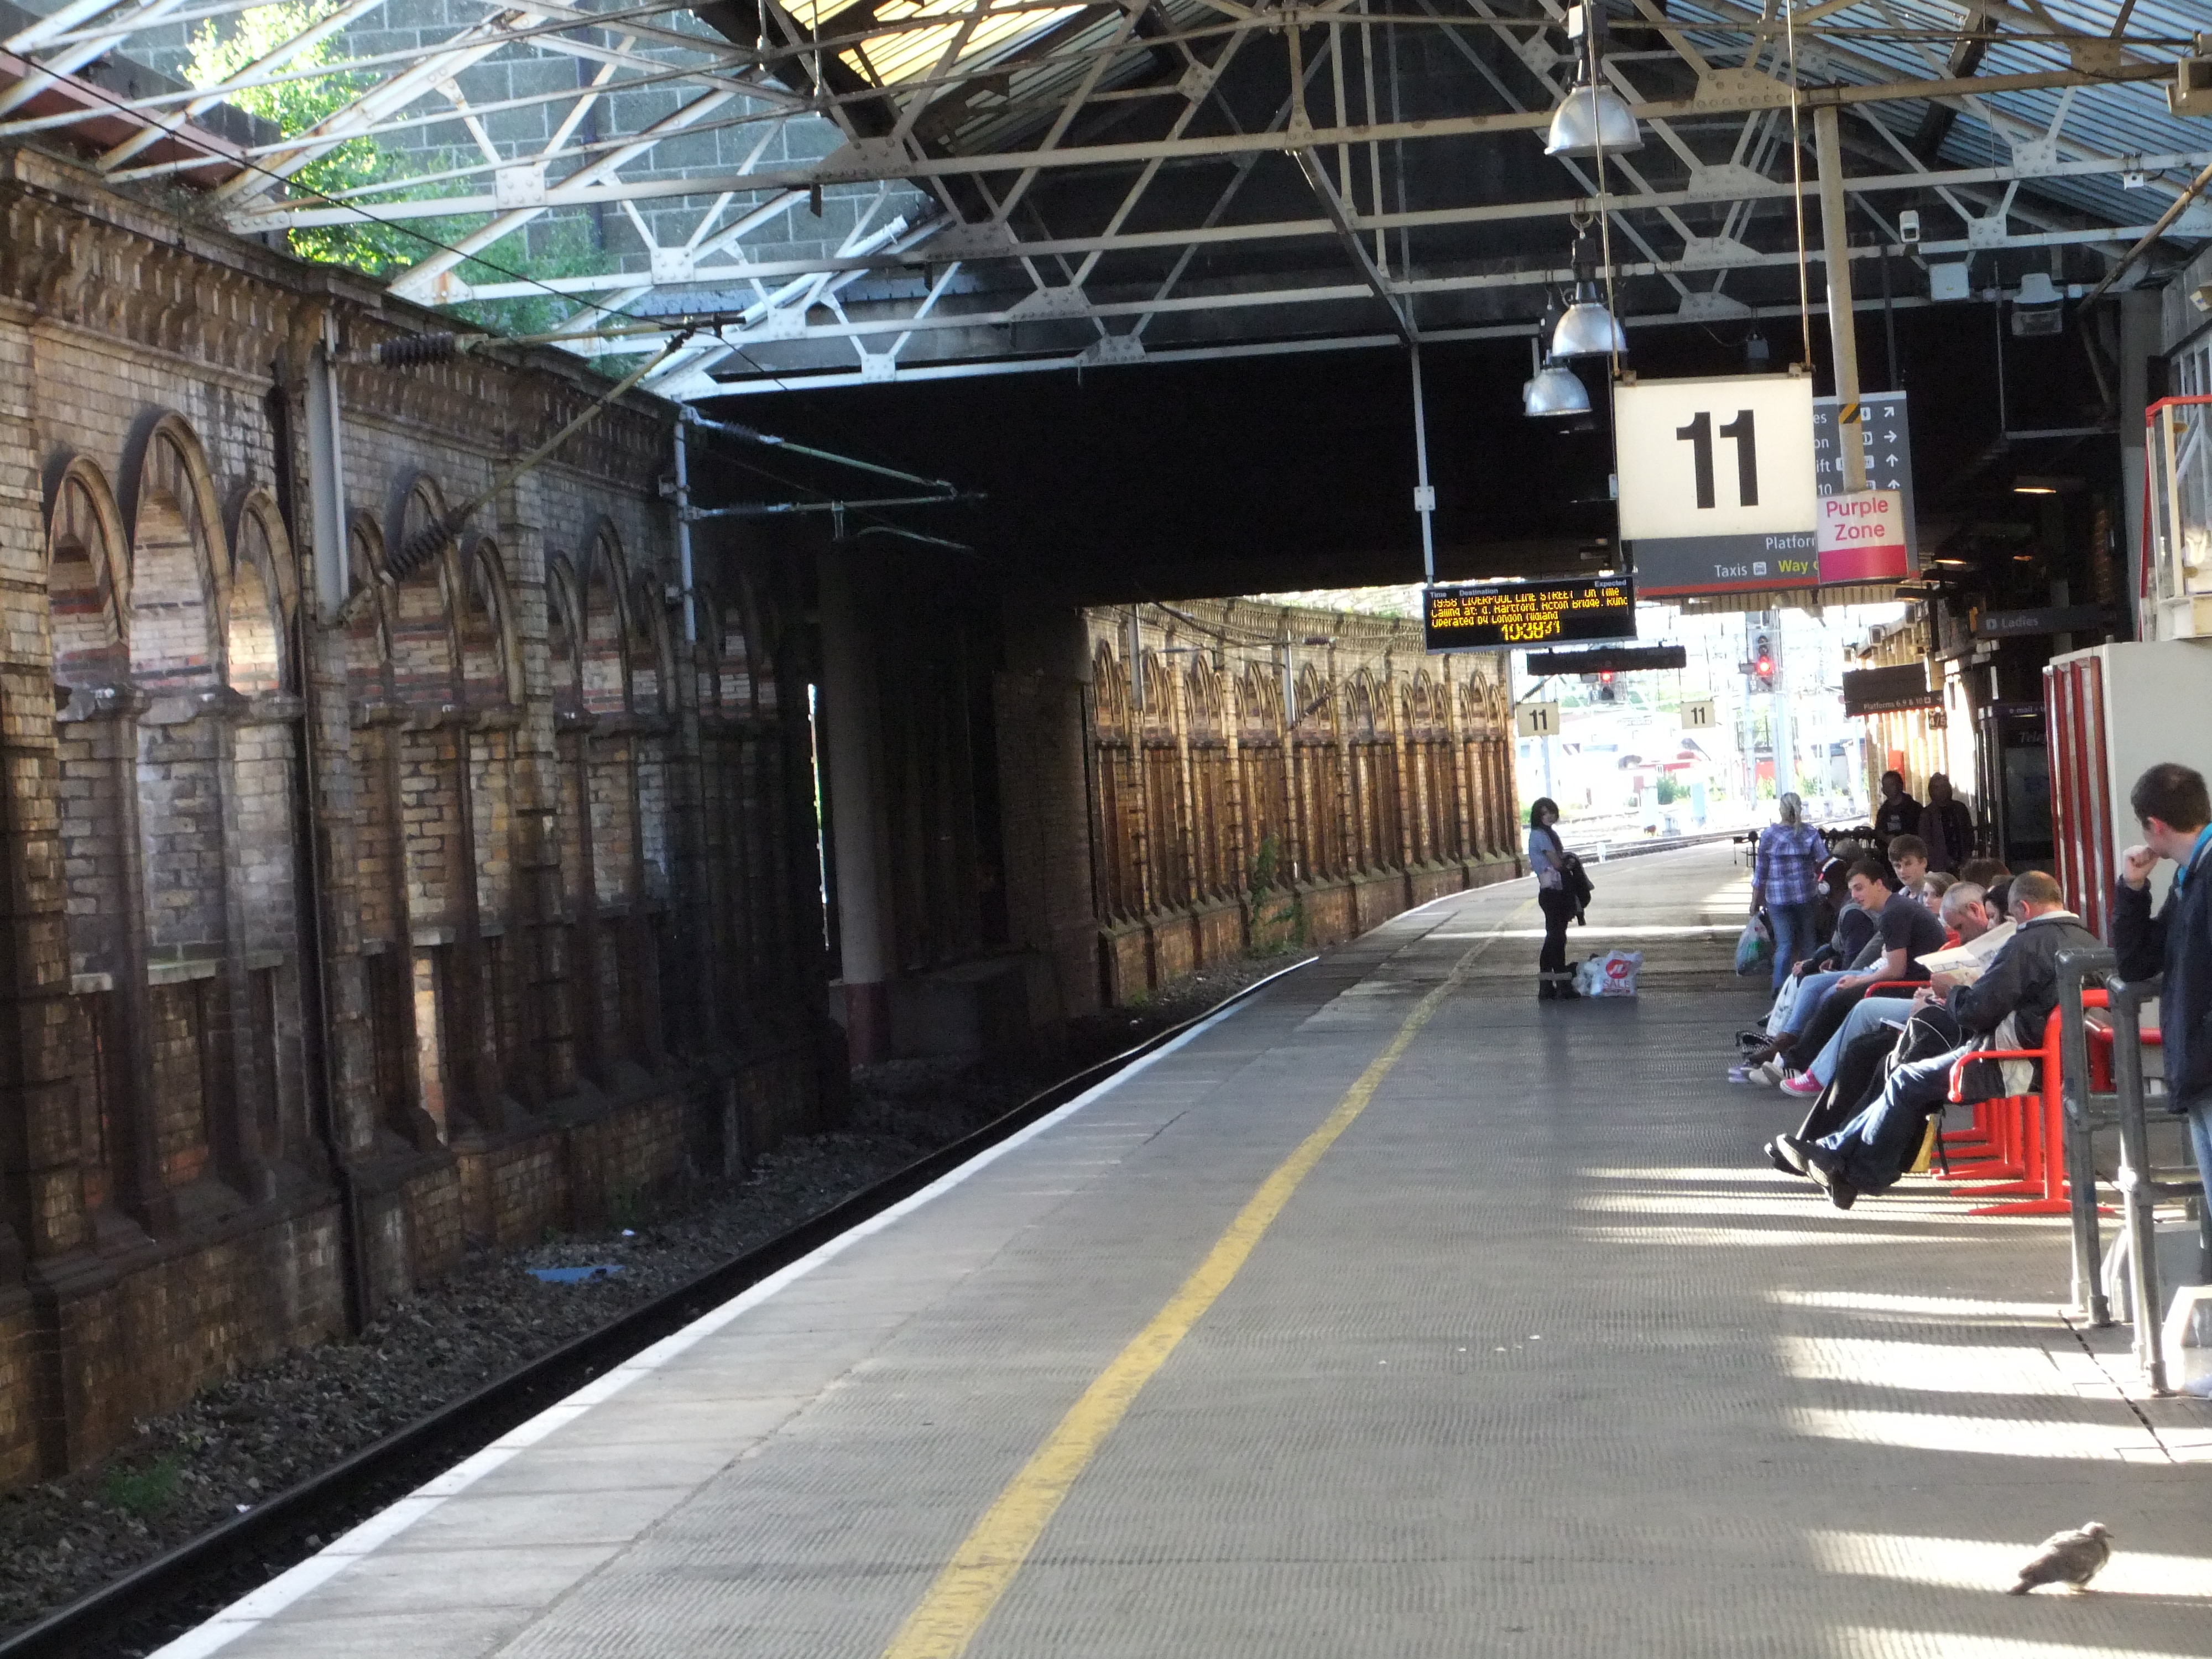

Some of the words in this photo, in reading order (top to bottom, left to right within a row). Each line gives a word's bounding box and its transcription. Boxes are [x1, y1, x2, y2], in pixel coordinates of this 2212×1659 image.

[1676, 409, 1759, 510] 11
[1825, 497, 1889, 519] Purple
[1834, 523, 1886, 541] Zone
[1714, 563, 1748, 578] Taxis
[1778, 560, 1809, 575] Way
[1459, 588, 1499, 597] Destination
[1594, 579, 1627, 587] Expected
[1462, 594, 1512, 606] LIVERPOOL
[1516, 592, 1537, 603] LIME
[1540, 589, 1574, 601] STREET
[1584, 588, 1597, 598] On
[1601, 587, 1620, 597] Time
[1430, 607, 1461, 618] Calling
[1464, 607, 1478, 616] at:
[1542, 601, 1569, 611] Acton
[1431, 616, 1474, 628] Operated
[1477, 615, 1489, 624] by
[1491, 613, 1524, 624] London
[1526, 611, 1559, 622] Midland
[2000, 615, 2039, 629] Ladies
[1691, 706, 1705, 724] 11
[1863, 701, 1895, 711] Platforms
[1529, 708, 1548, 731] 11
